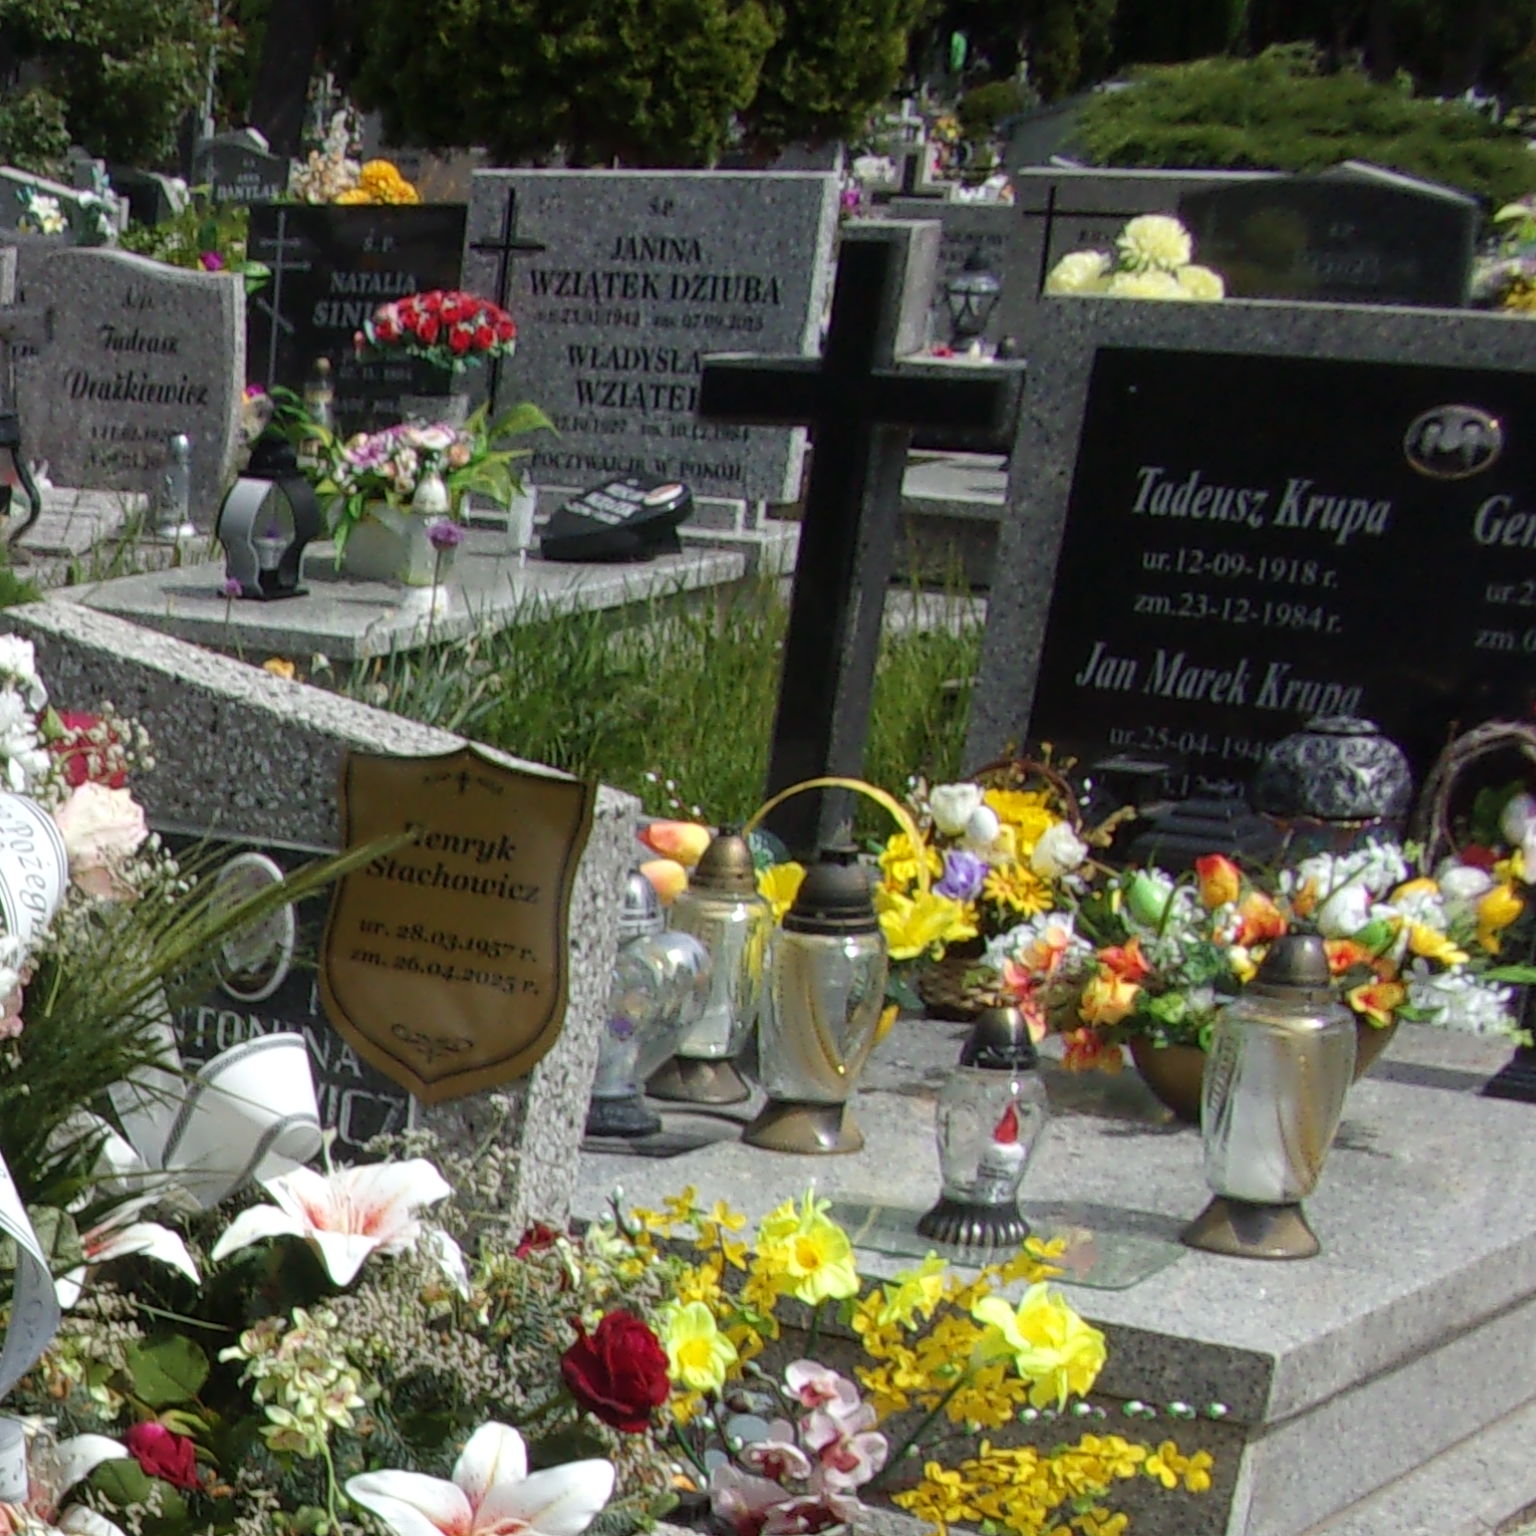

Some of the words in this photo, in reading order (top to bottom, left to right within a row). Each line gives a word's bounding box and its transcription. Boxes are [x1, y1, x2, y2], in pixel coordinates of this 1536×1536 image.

[609, 235, 703, 263] JANINA
[329, 270, 418, 294] NATALIA
[529, 269, 660, 305] WZIĄTEK
[668, 273, 781, 306] DZIUBA
[1132, 466, 1269, 530] Tadeusz
[1274, 478, 1392, 545] Krupa
[1075, 641, 1135, 691] Jan
[1143, 647, 1250, 707] Marek
[1257, 660, 1365, 721] Krupa
[364, 855, 541, 903] Stachowicz
[359, 918, 390, 937] ur.
[350, 948, 387, 967] zm.
[392, 954, 517, 994] 26.04.2025
